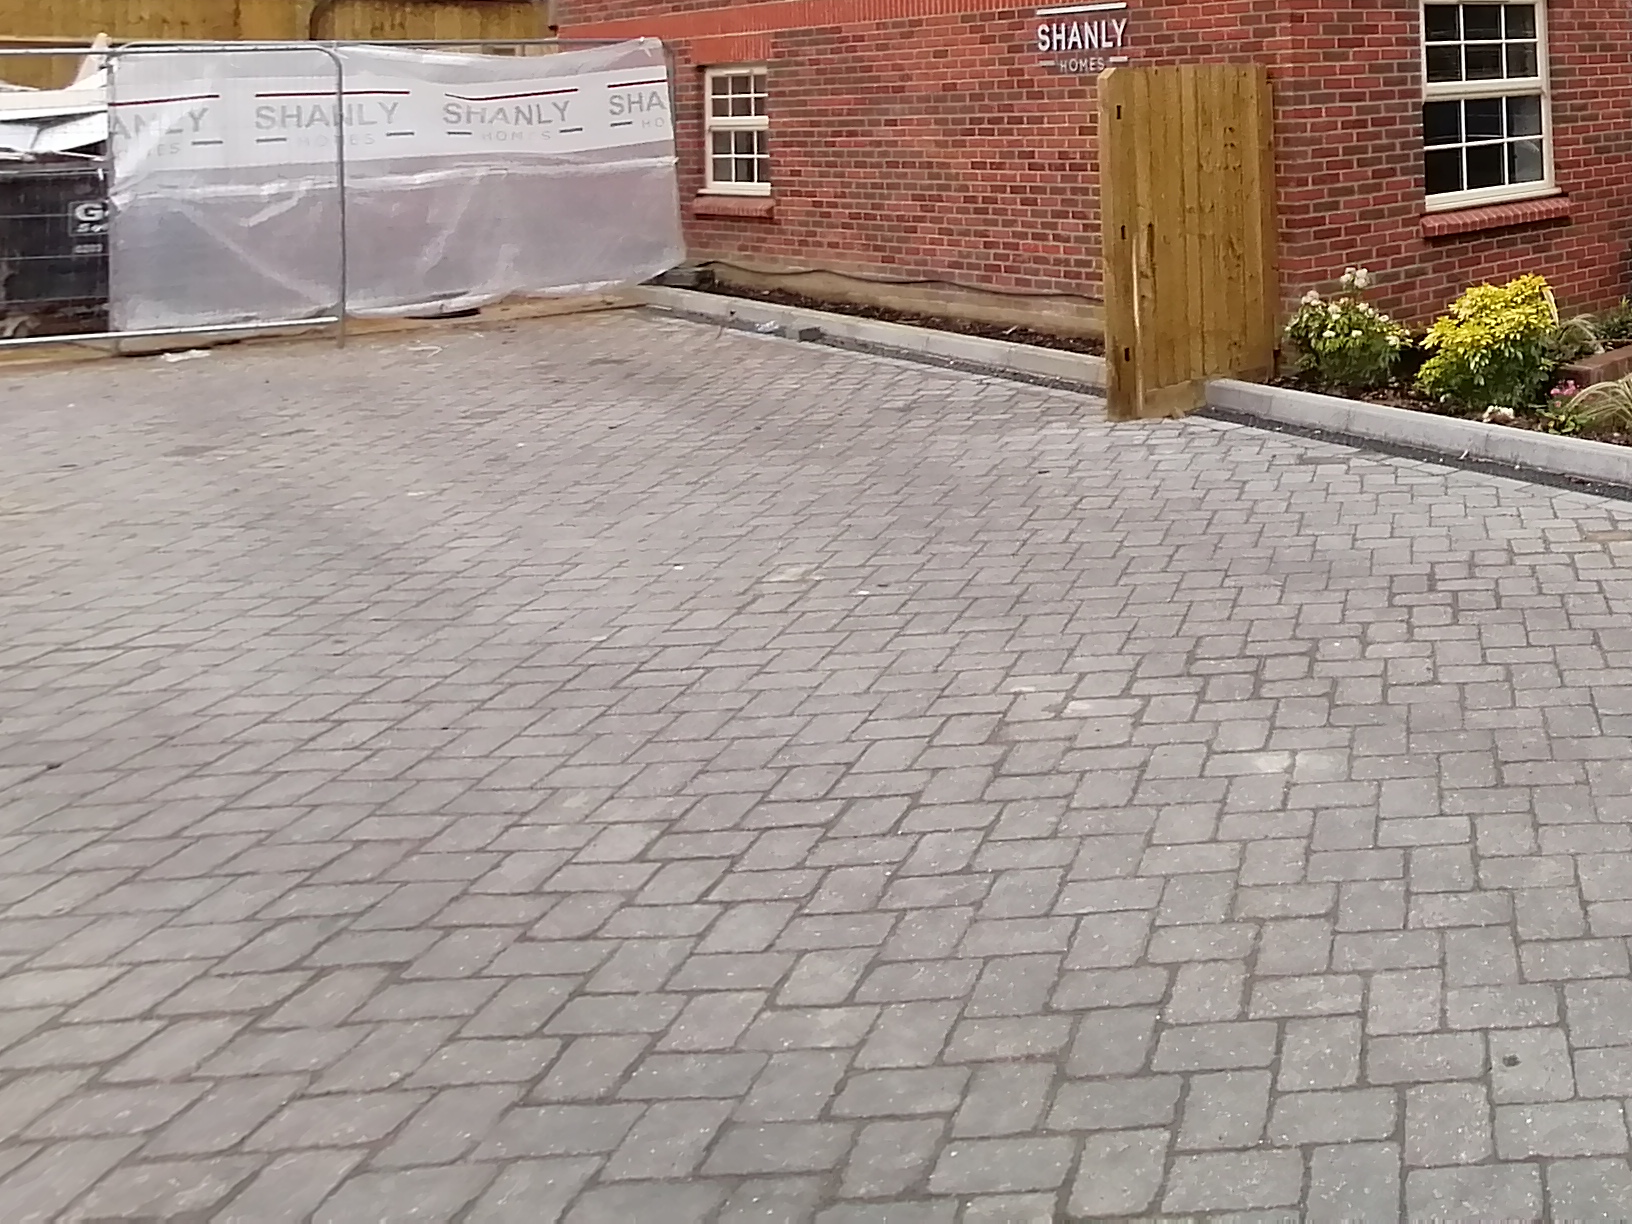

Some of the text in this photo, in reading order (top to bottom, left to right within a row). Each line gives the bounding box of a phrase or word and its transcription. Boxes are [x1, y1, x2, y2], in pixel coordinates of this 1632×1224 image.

[1037, 18, 1128, 52] SHANLY
[1060, 57, 1105, 73] HOMES
[254, 101, 399, 130] SHANLY
[442, 100, 571, 126] SHANLY
